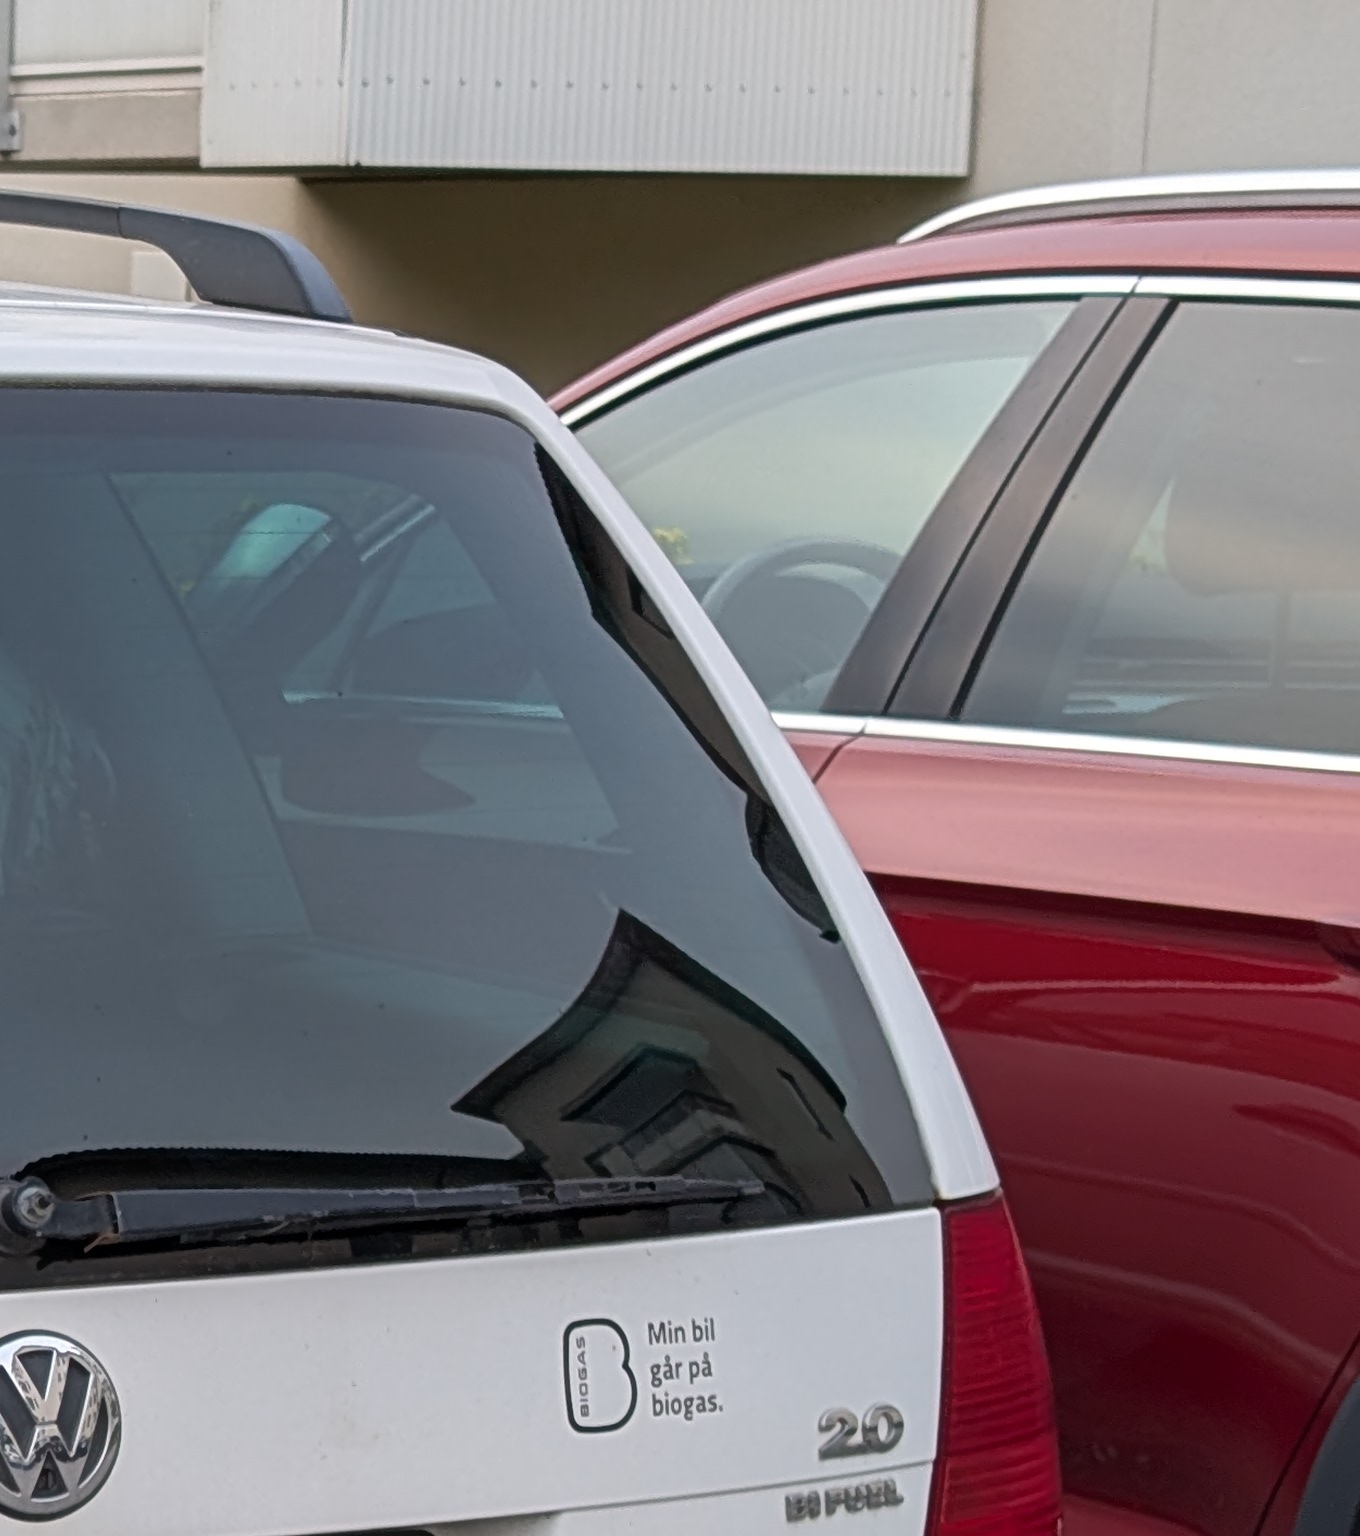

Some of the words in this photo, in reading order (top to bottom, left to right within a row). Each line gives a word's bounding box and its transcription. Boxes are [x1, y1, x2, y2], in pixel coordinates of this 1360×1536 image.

[647, 1321, 686, 1345] Min
[691, 1317, 716, 1342] bil
[576, 1336, 590, 1417] BIOGAS
[650, 1354, 683, 1388] går
[689, 1351, 713, 1384] på
[651, 1391, 724, 1421] biogas.
